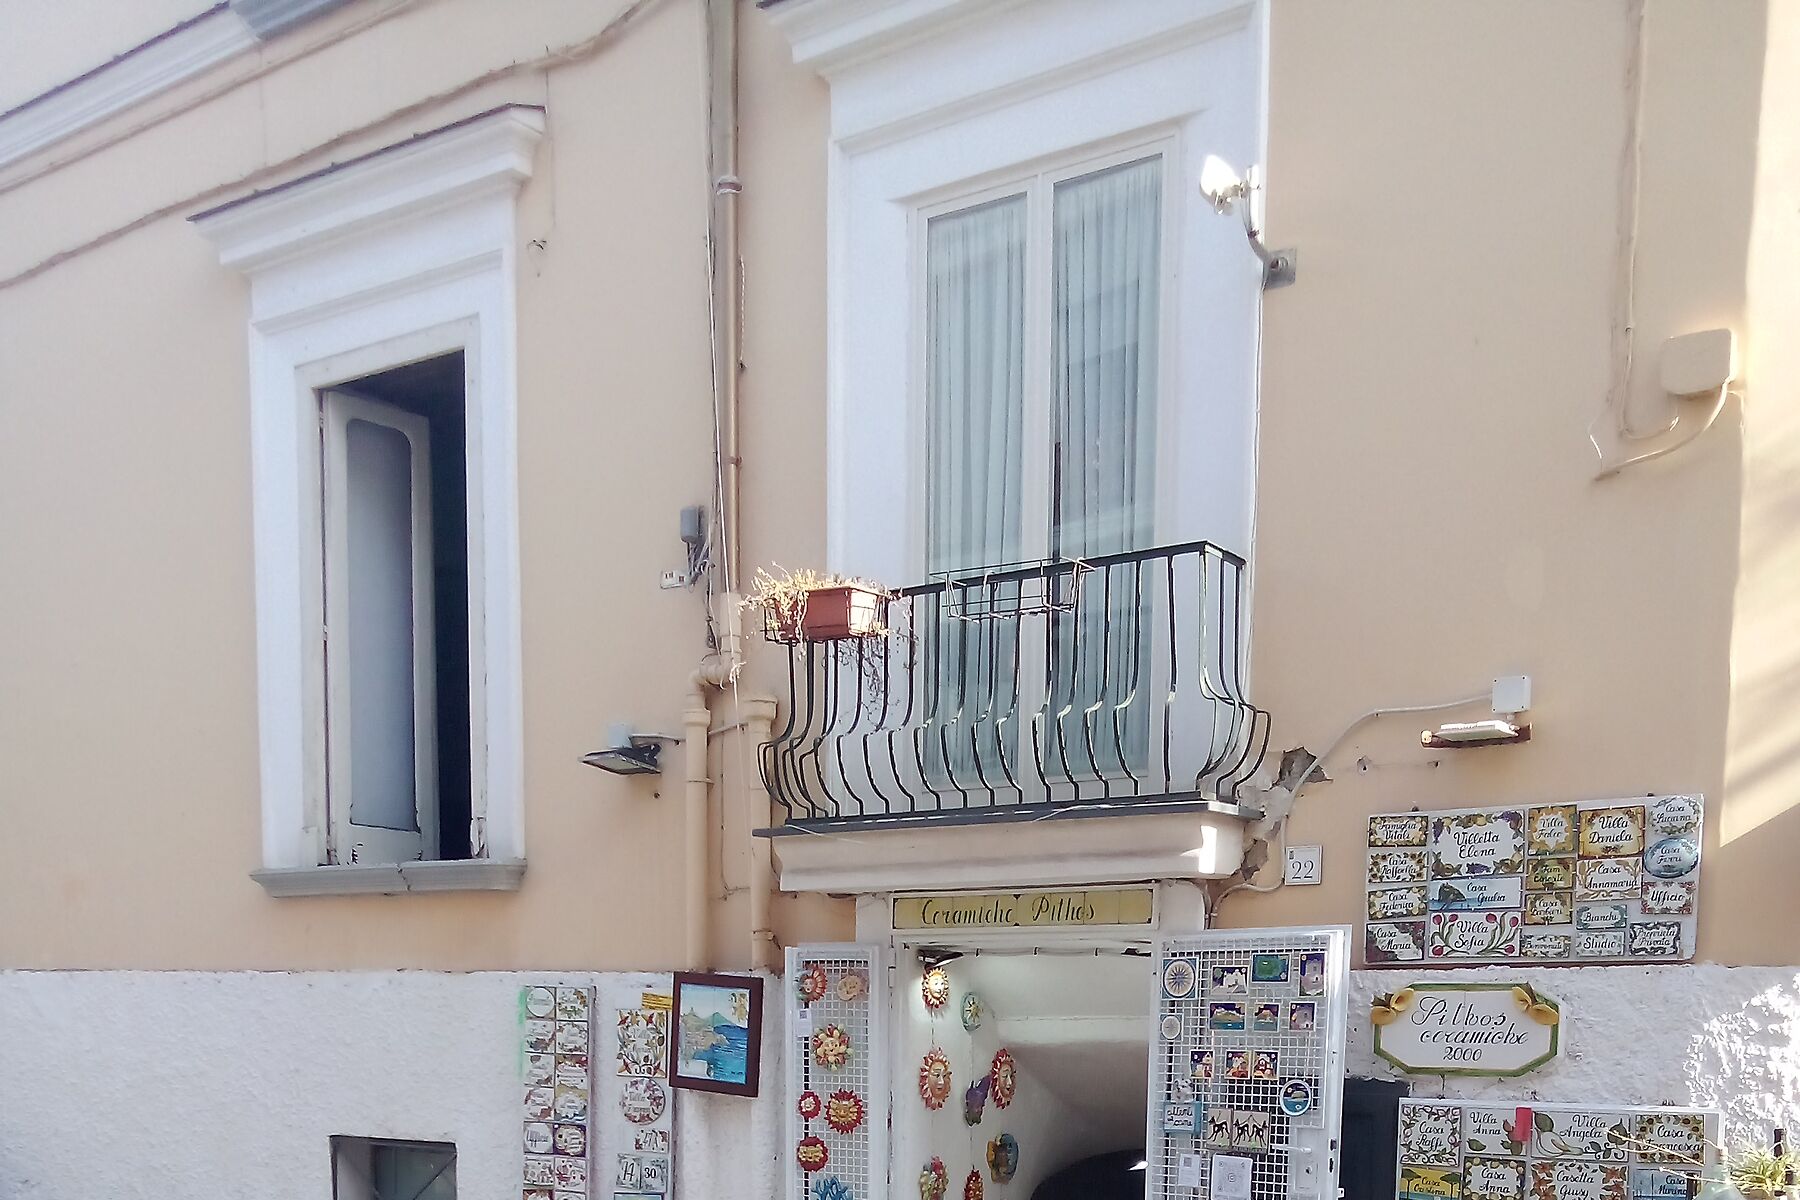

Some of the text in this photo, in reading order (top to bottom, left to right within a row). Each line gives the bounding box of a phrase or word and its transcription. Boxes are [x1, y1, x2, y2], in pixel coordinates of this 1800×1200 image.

[1665, 804, 1685, 813] Casa
[1599, 816, 1628, 830] Villa
[1453, 830, 1500, 846] Villetta
[1589, 830, 1633, 844] Daniela
[1459, 845, 1496, 859] Elena
[1292, 860, 1314, 880] 22
[1597, 863, 1621, 875] Casa
[1466, 882, 1487, 892] Casa
[1388, 892, 1407, 902] Casa
[921, 899, 1013, 925] Ceramiche
[1376, 927, 1398, 939] Casa
[1456, 920, 1489, 934] Villa
[1442, 1046, 1483, 1061] 2000
[1470, 1111, 1498, 1124] Villa
[1570, 1114, 1607, 1128] Villa
[1420, 1121, 1444, 1134] Casa
[1472, 1124, 1501, 1135] Anna
[1559, 1126, 1603, 1142] Angela
[1657, 1125, 1684, 1138] Casa
[644, 1167, 657, 1179] 30
[1481, 1167, 1507, 1180] Casa
[1556, 1170, 1595, 1184] Casetta
[1478, 1180, 1511, 1194] Anna
